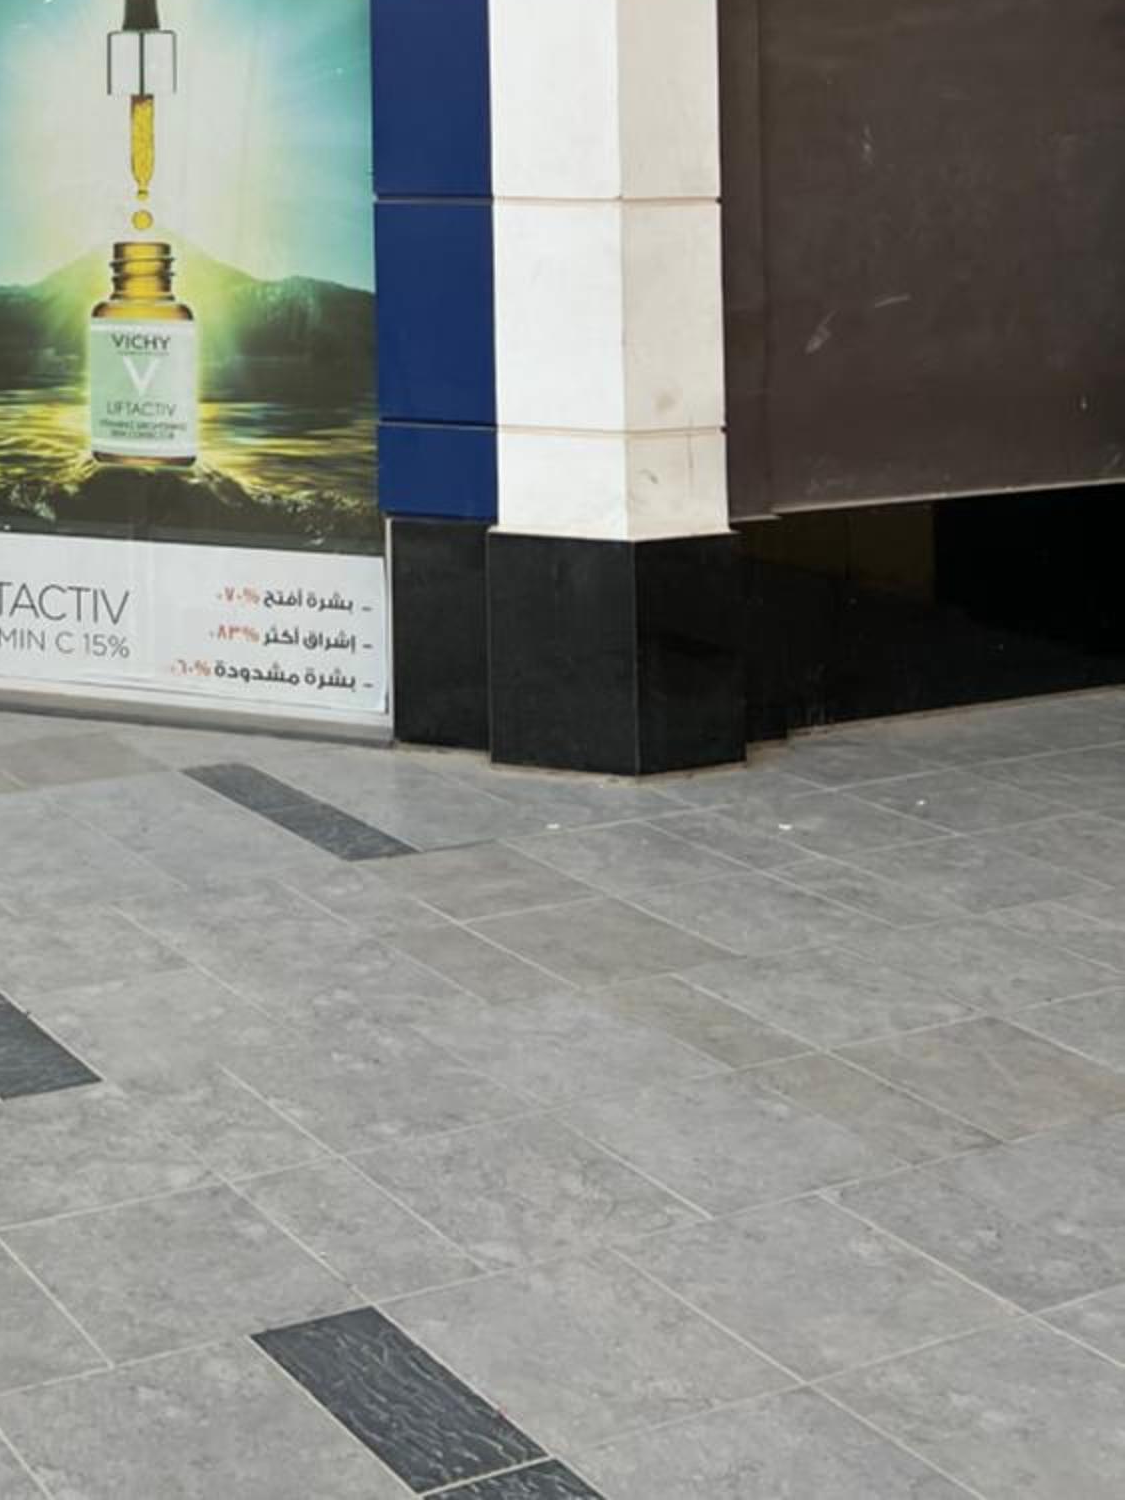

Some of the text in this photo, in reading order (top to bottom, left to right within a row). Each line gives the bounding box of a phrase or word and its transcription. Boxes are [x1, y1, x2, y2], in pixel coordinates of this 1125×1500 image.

[111, 333, 171, 350] VICHY
[106, 401, 178, 416] LIFTACTIV
[55, 630, 76, 656] C
[83, 633, 131, 660] 15%
